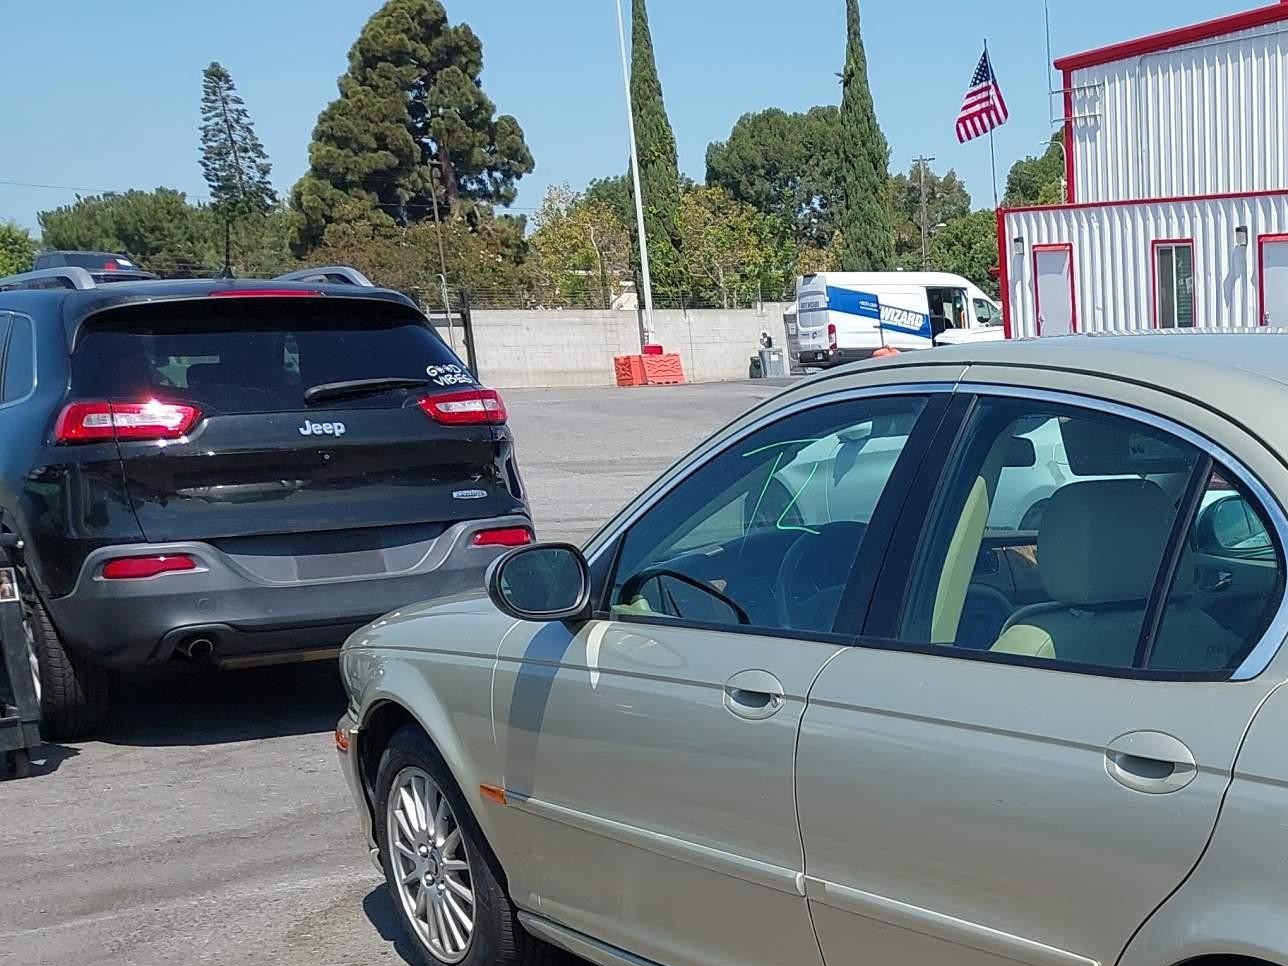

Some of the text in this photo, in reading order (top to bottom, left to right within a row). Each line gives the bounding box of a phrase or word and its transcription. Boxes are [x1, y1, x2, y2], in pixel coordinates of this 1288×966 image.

[880, 306, 922, 329] WIZARD
[432, 374, 473, 386] VIBES
[298, 419, 346, 437] Jeep
